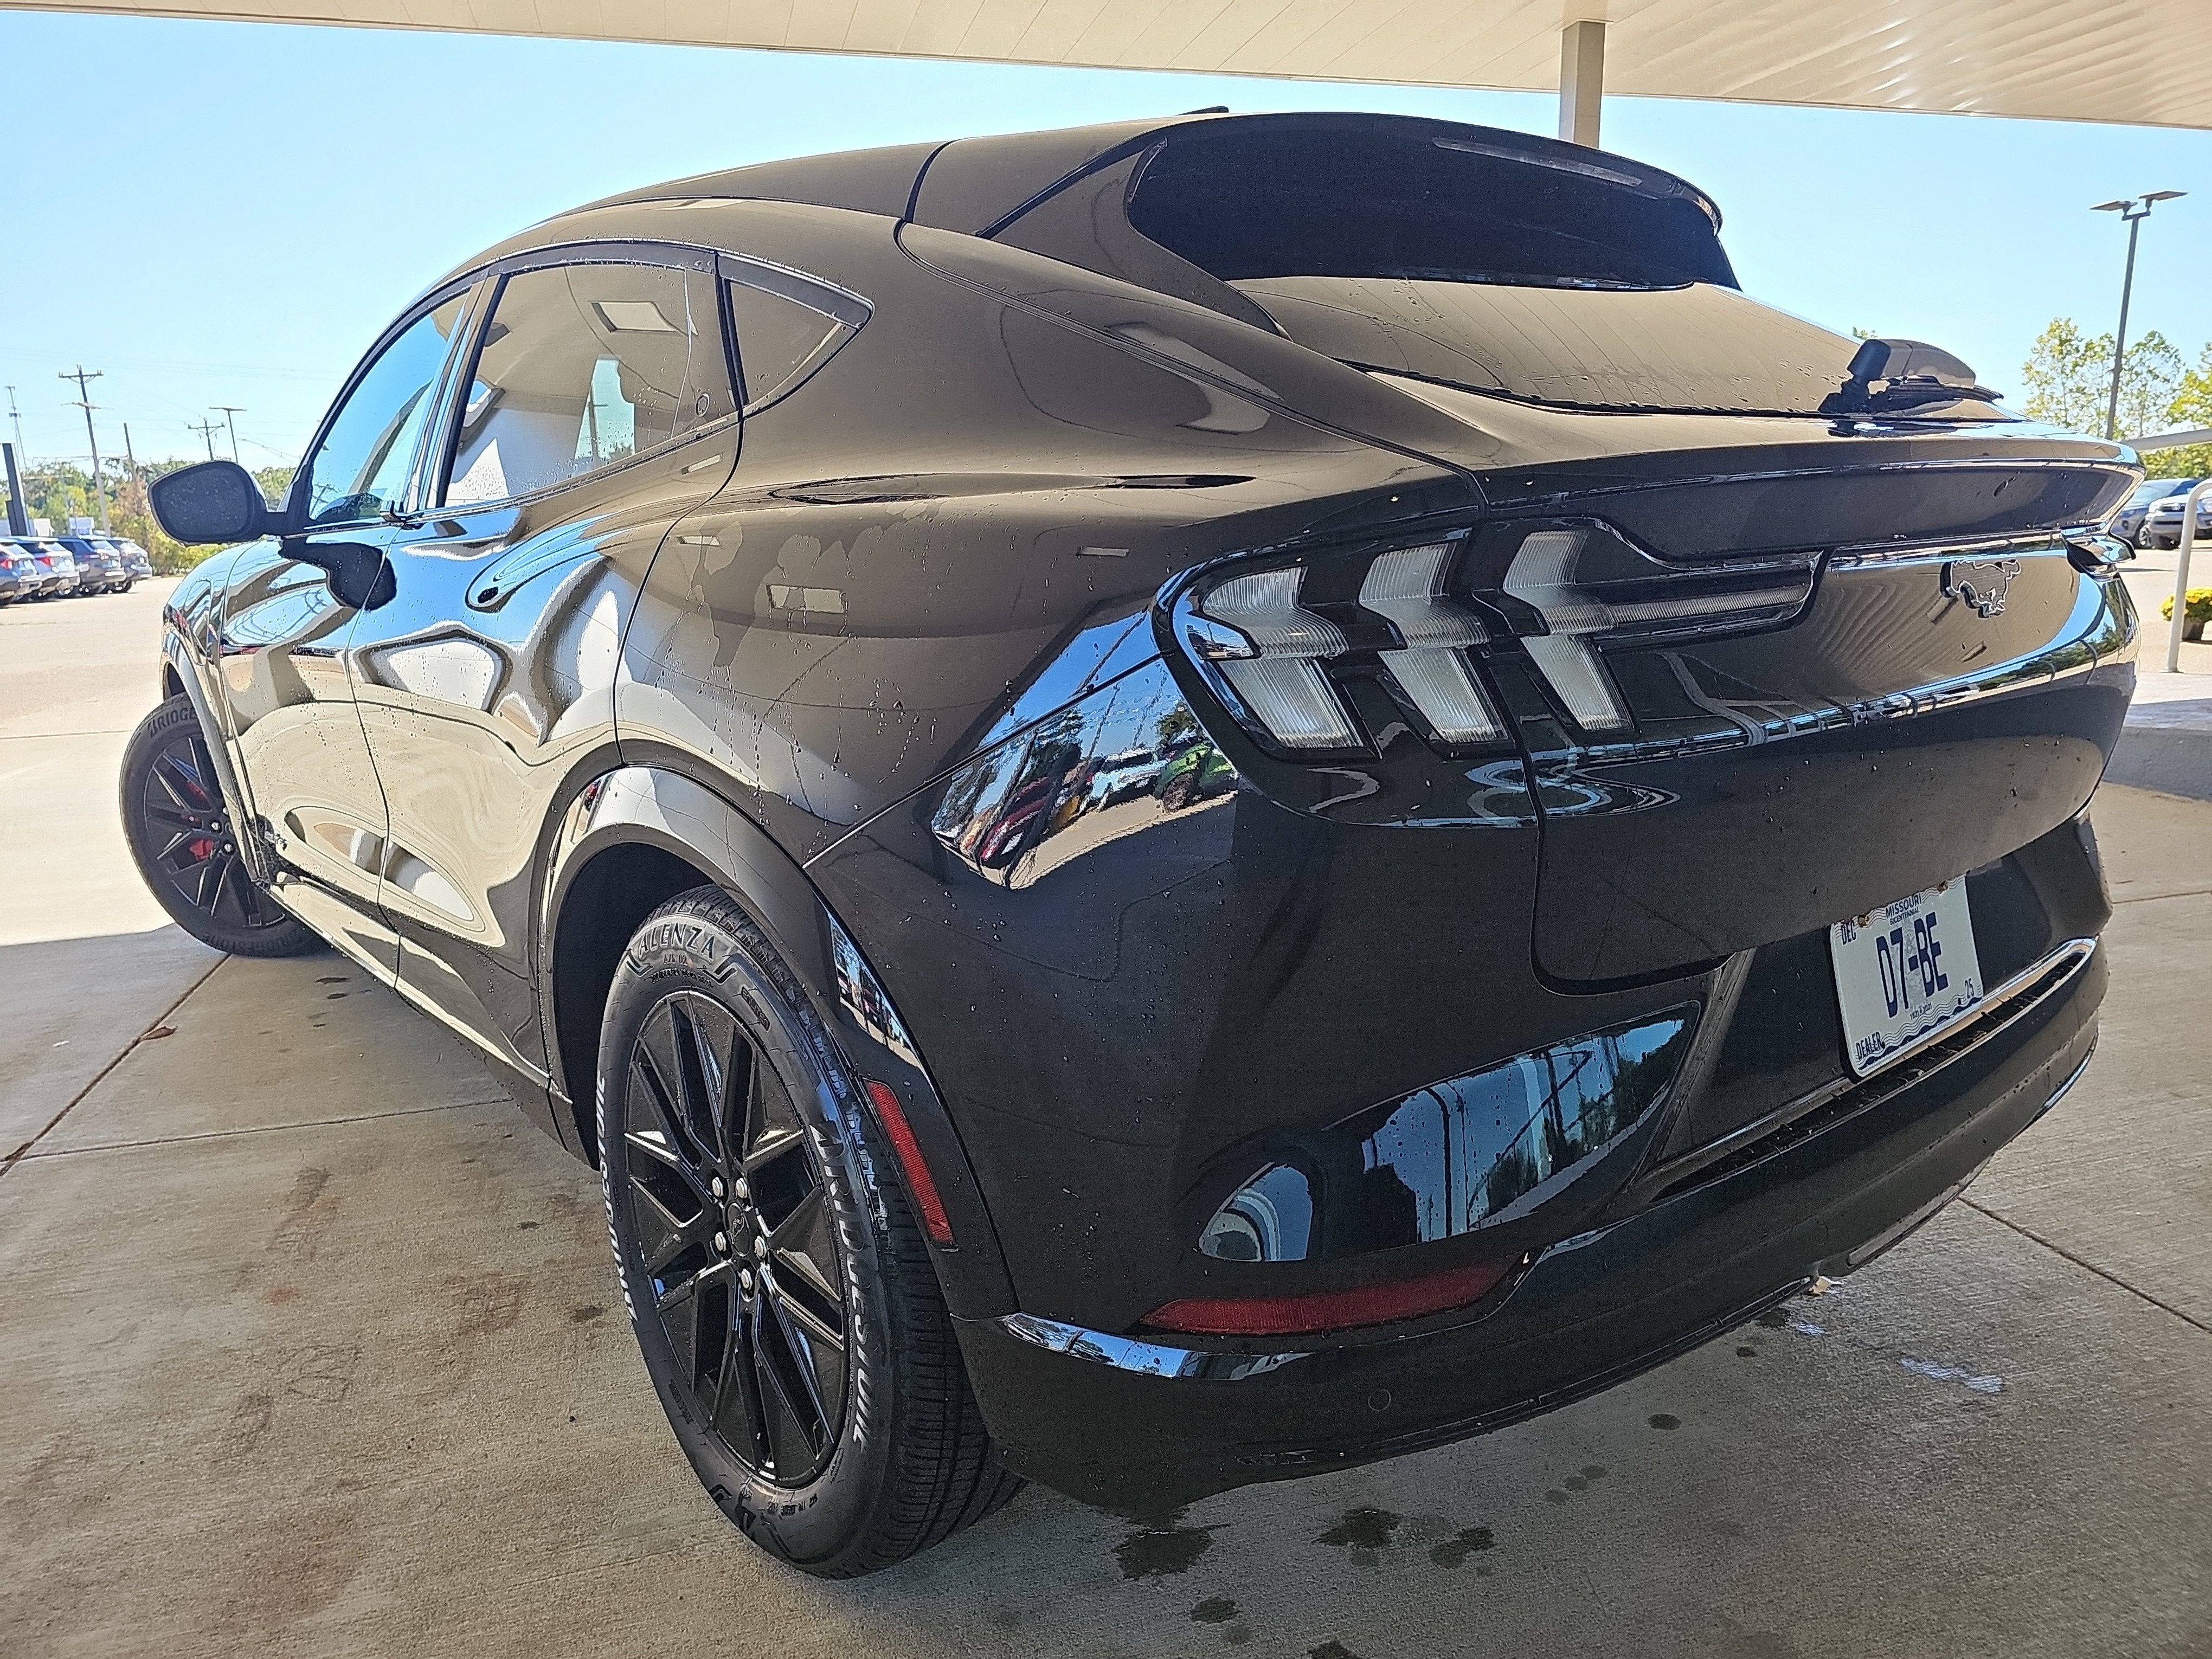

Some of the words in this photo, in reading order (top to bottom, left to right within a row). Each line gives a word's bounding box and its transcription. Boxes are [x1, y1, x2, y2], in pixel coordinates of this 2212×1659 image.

[1886, 893, 1922, 919] MISSOURI
[1890, 906, 1920, 925] BICENTENNIAL
[638, 923, 715, 960] ALENZA
[1841, 919, 1856, 946] DEC
[1876, 911, 1949, 1019] D7-BE
[1964, 978, 1974, 998] 25
[1909, 1007, 1920, 1020] 1821
[1855, 1031, 1883, 1060] DEALER
